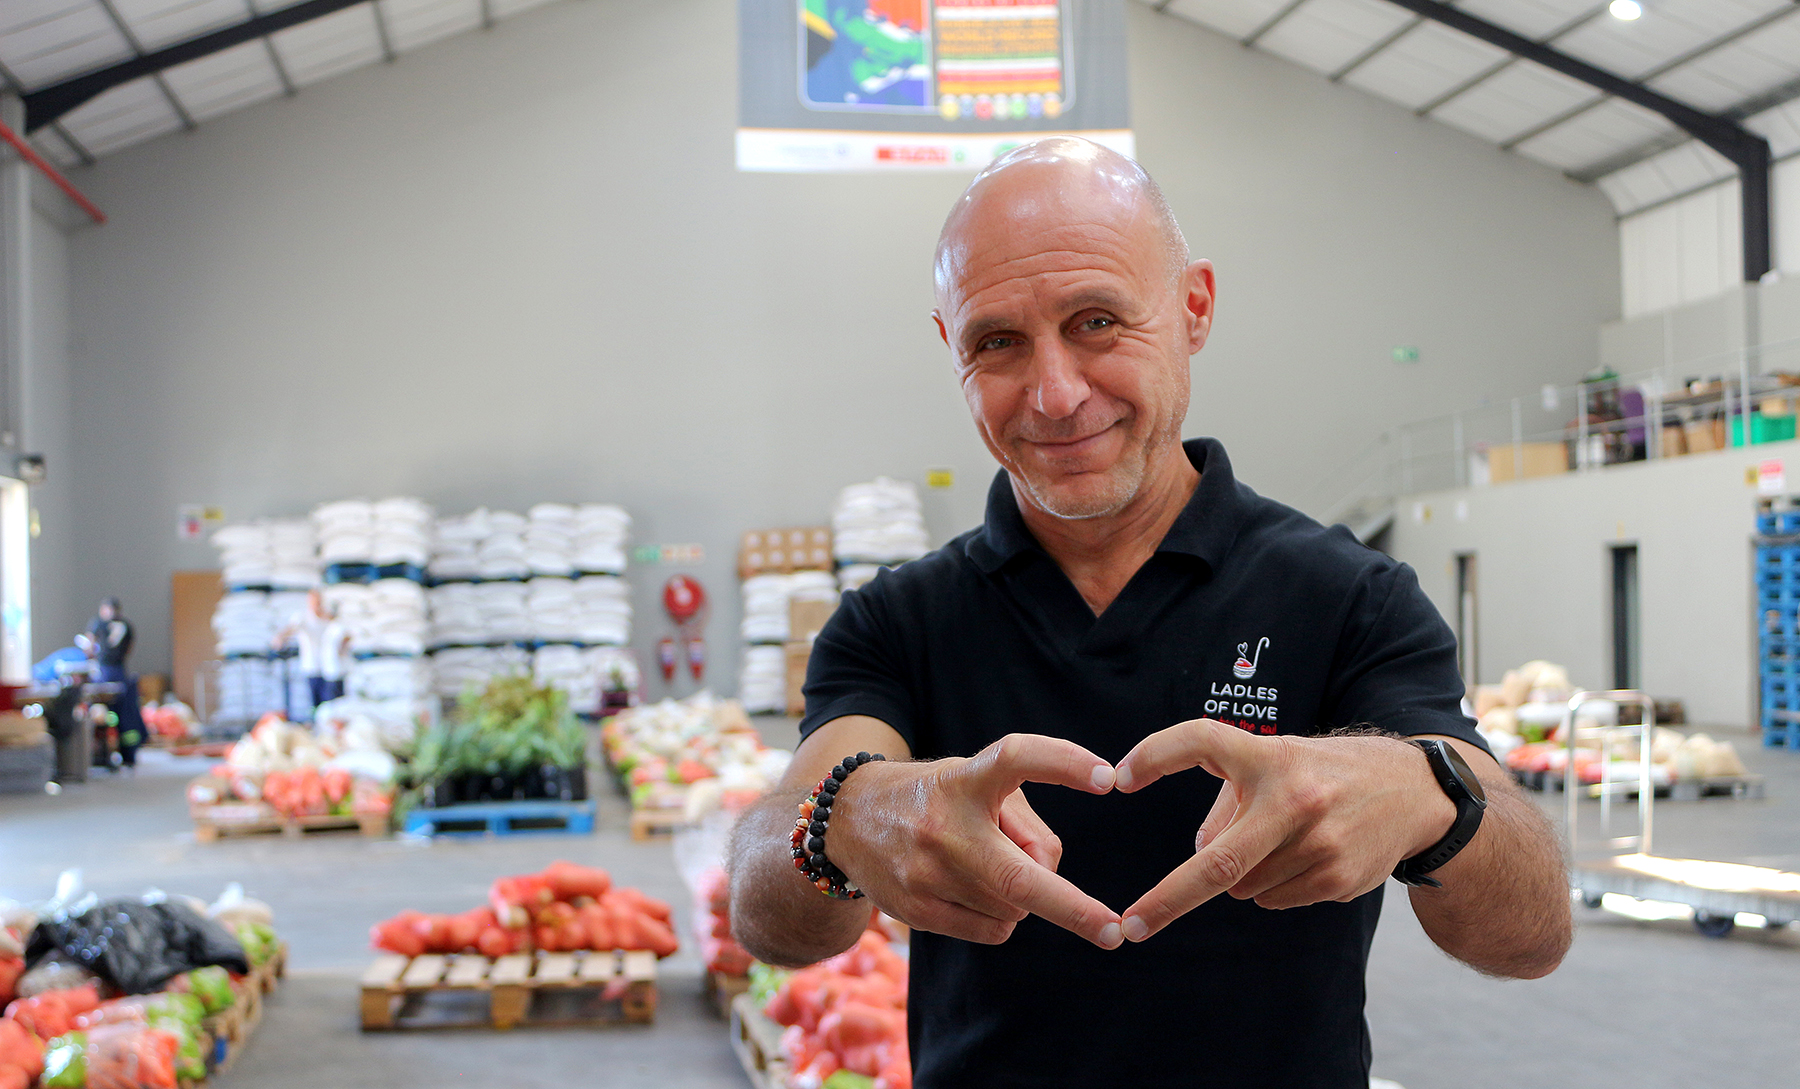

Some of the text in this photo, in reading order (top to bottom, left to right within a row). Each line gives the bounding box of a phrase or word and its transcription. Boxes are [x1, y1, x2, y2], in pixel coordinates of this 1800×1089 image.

[1211, 682, 1278, 701] LADLES
[1204, 699, 1278, 720] OF LOVE
[1239, 719, 1256, 731] the
[1260, 723, 1277, 734] soul
